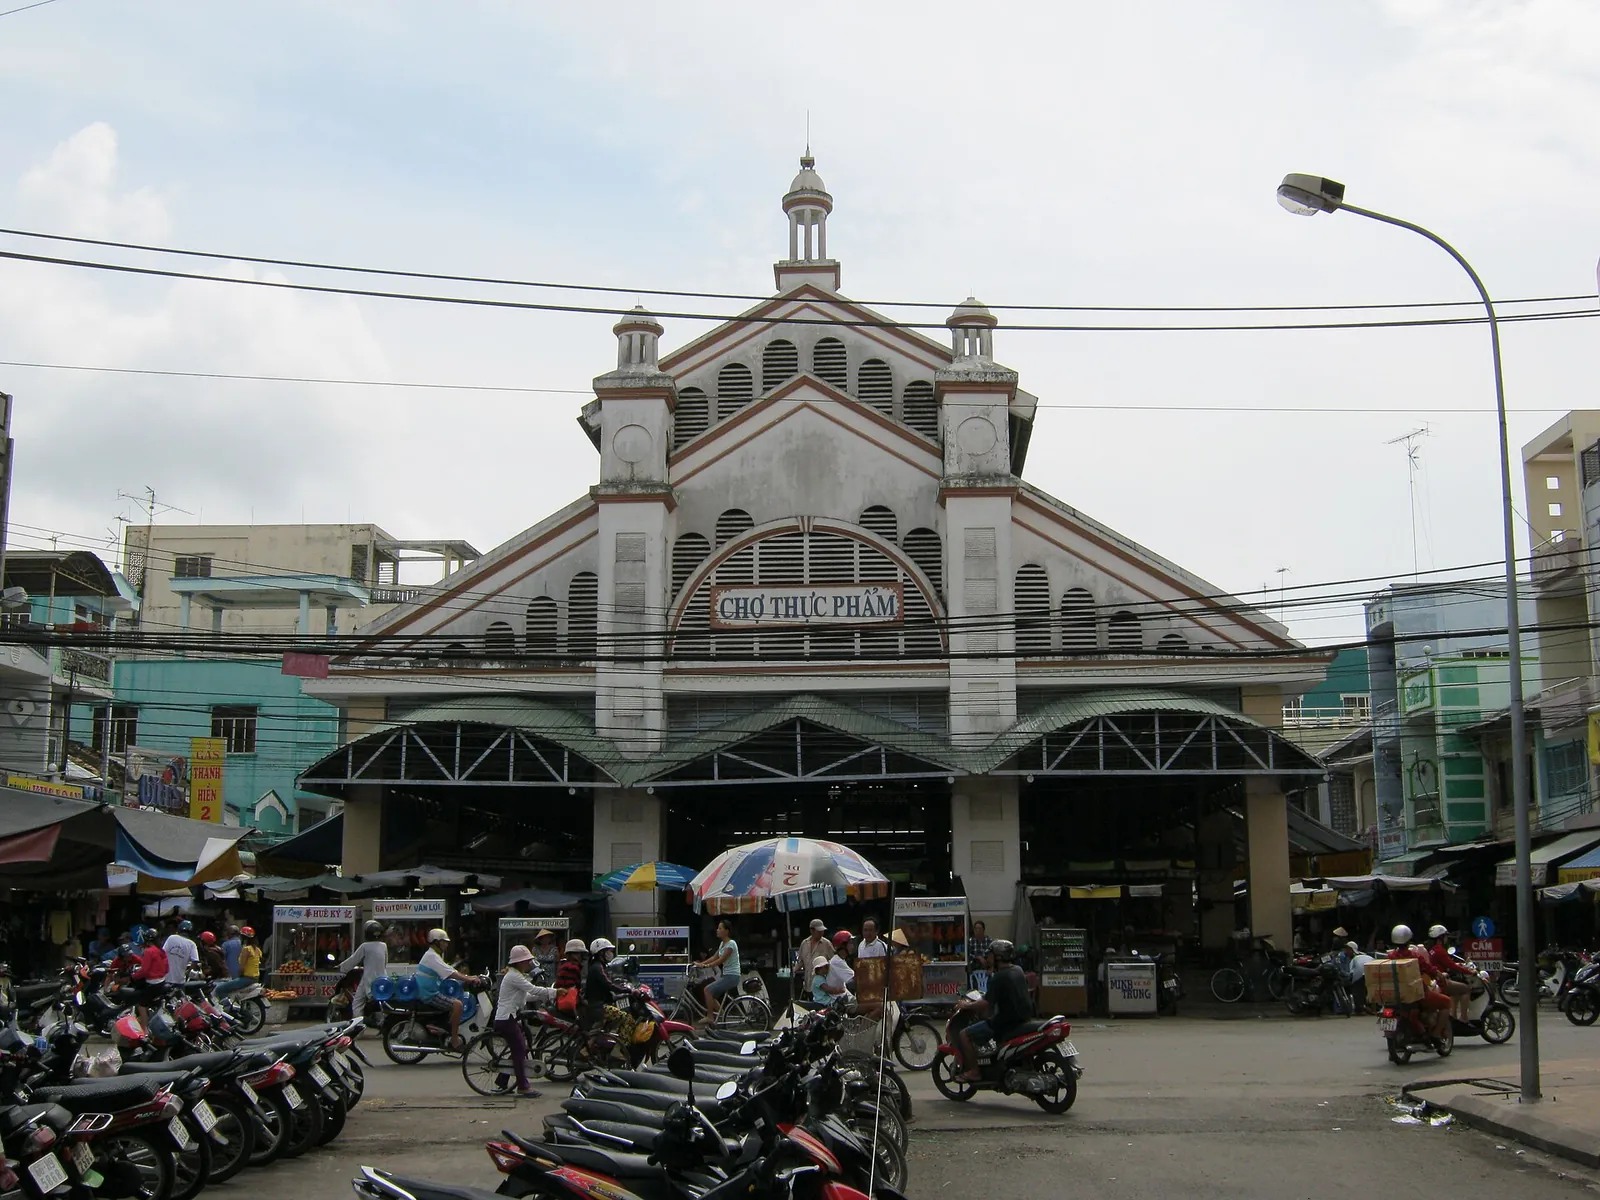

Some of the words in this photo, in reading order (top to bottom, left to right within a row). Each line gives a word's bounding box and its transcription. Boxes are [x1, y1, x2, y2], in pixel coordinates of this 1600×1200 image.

[720, 594, 765, 624] CHỢ
[770, 590, 827, 623] THỰC
[832, 587, 896, 617] PHẨM
[193, 767, 221, 780] THANH
[200, 806, 211, 820] 2
[1471, 940, 1493, 951] CẤM
[1110, 979, 1133, 990] MINH
[1122, 988, 1152, 1000] TRUNG
